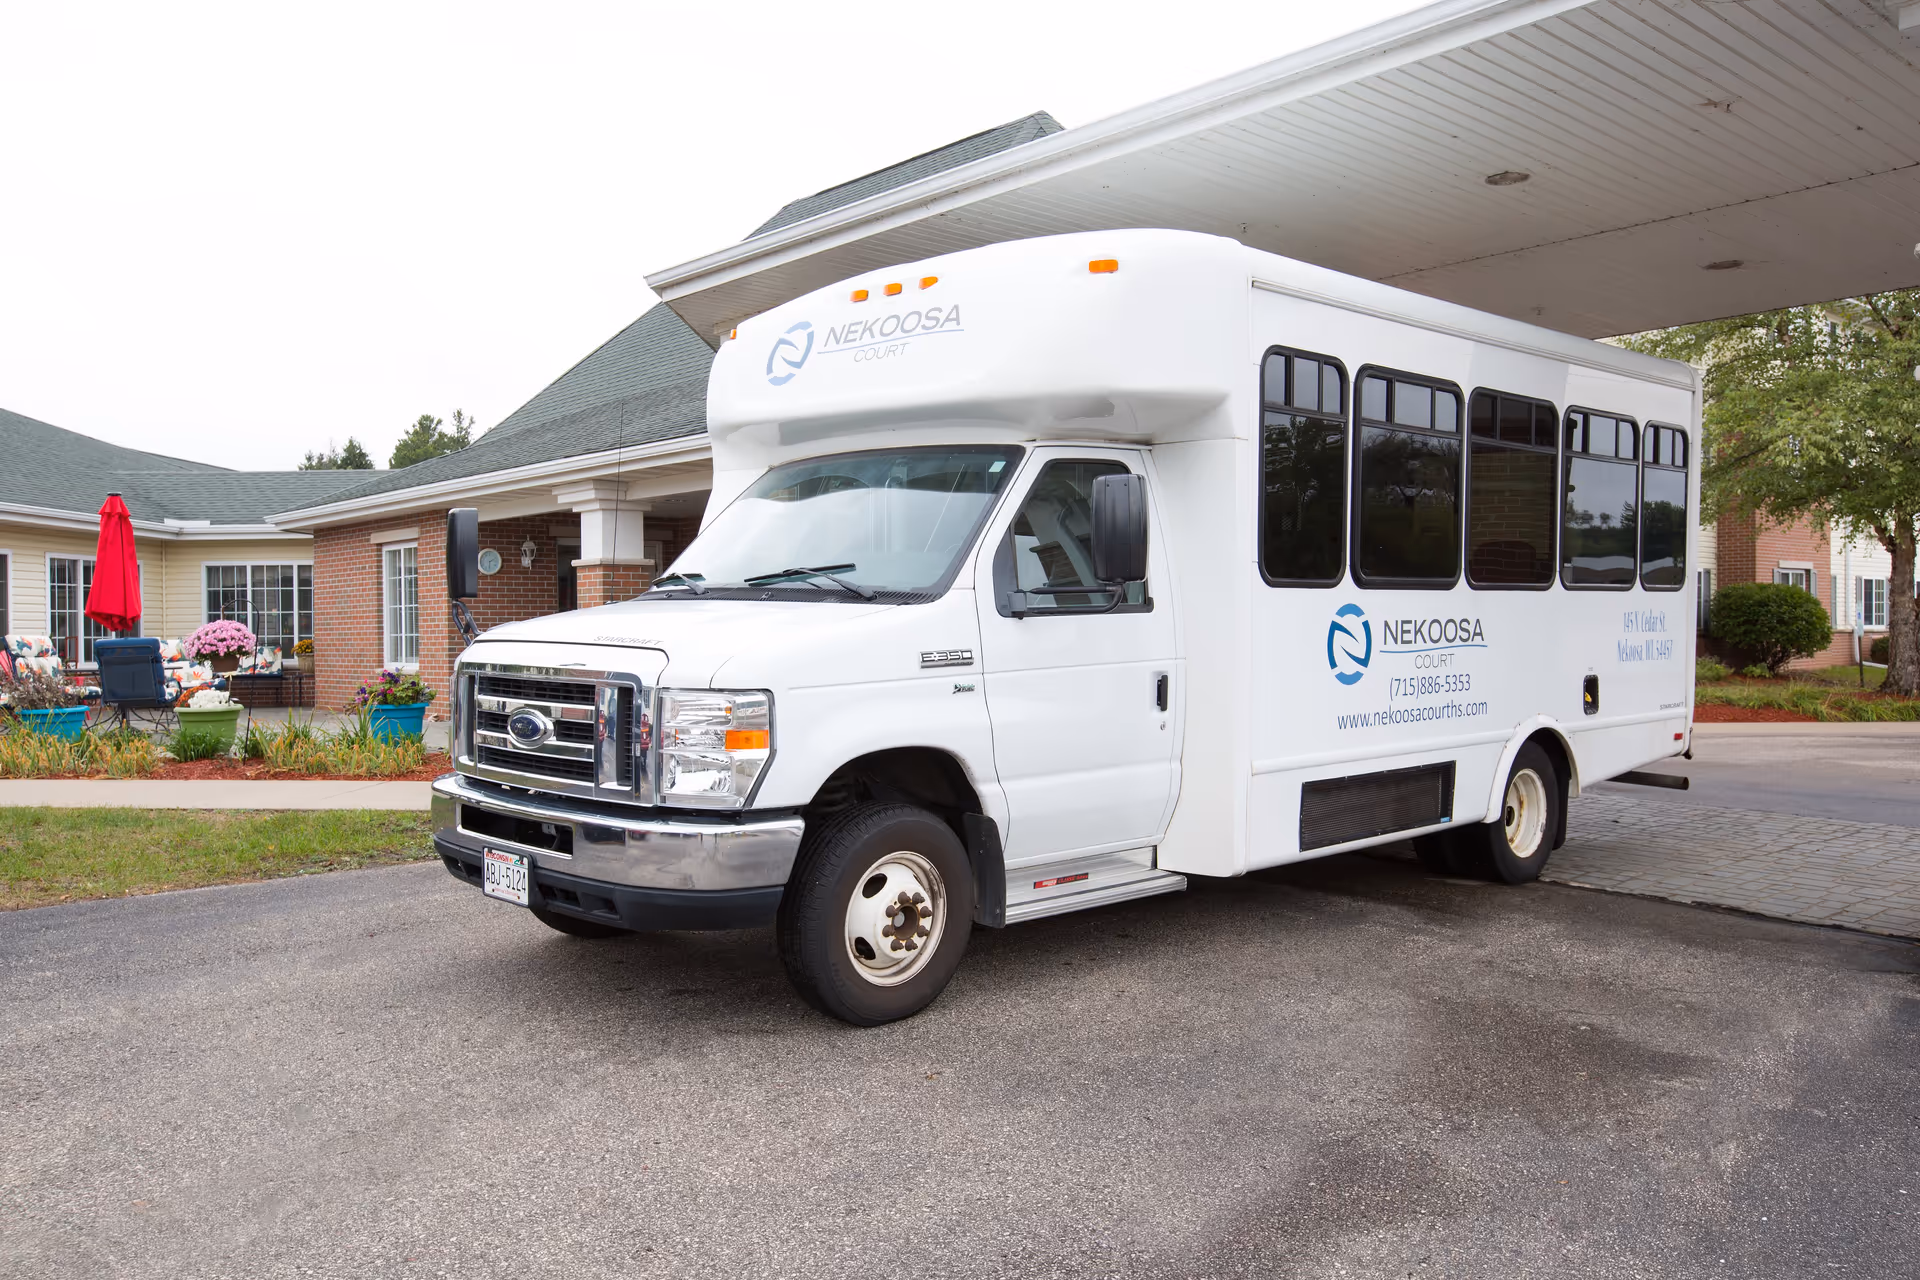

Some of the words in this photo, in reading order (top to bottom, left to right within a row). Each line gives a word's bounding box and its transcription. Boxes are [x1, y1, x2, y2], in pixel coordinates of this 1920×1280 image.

[824, 304, 961, 347] NEKOOSA
[853, 342, 910, 363] COURT
[1383, 618, 1485, 645] NEKOOSA
[1641, 608, 1659, 633] Cedar
[1414, 653, 1455, 669] COURT
[1389, 673, 1471, 701] (715)886-5353
[1337, 699, 1488, 730] www.nekoosacourths.com
[486, 862, 526, 894] ABJ-5124
